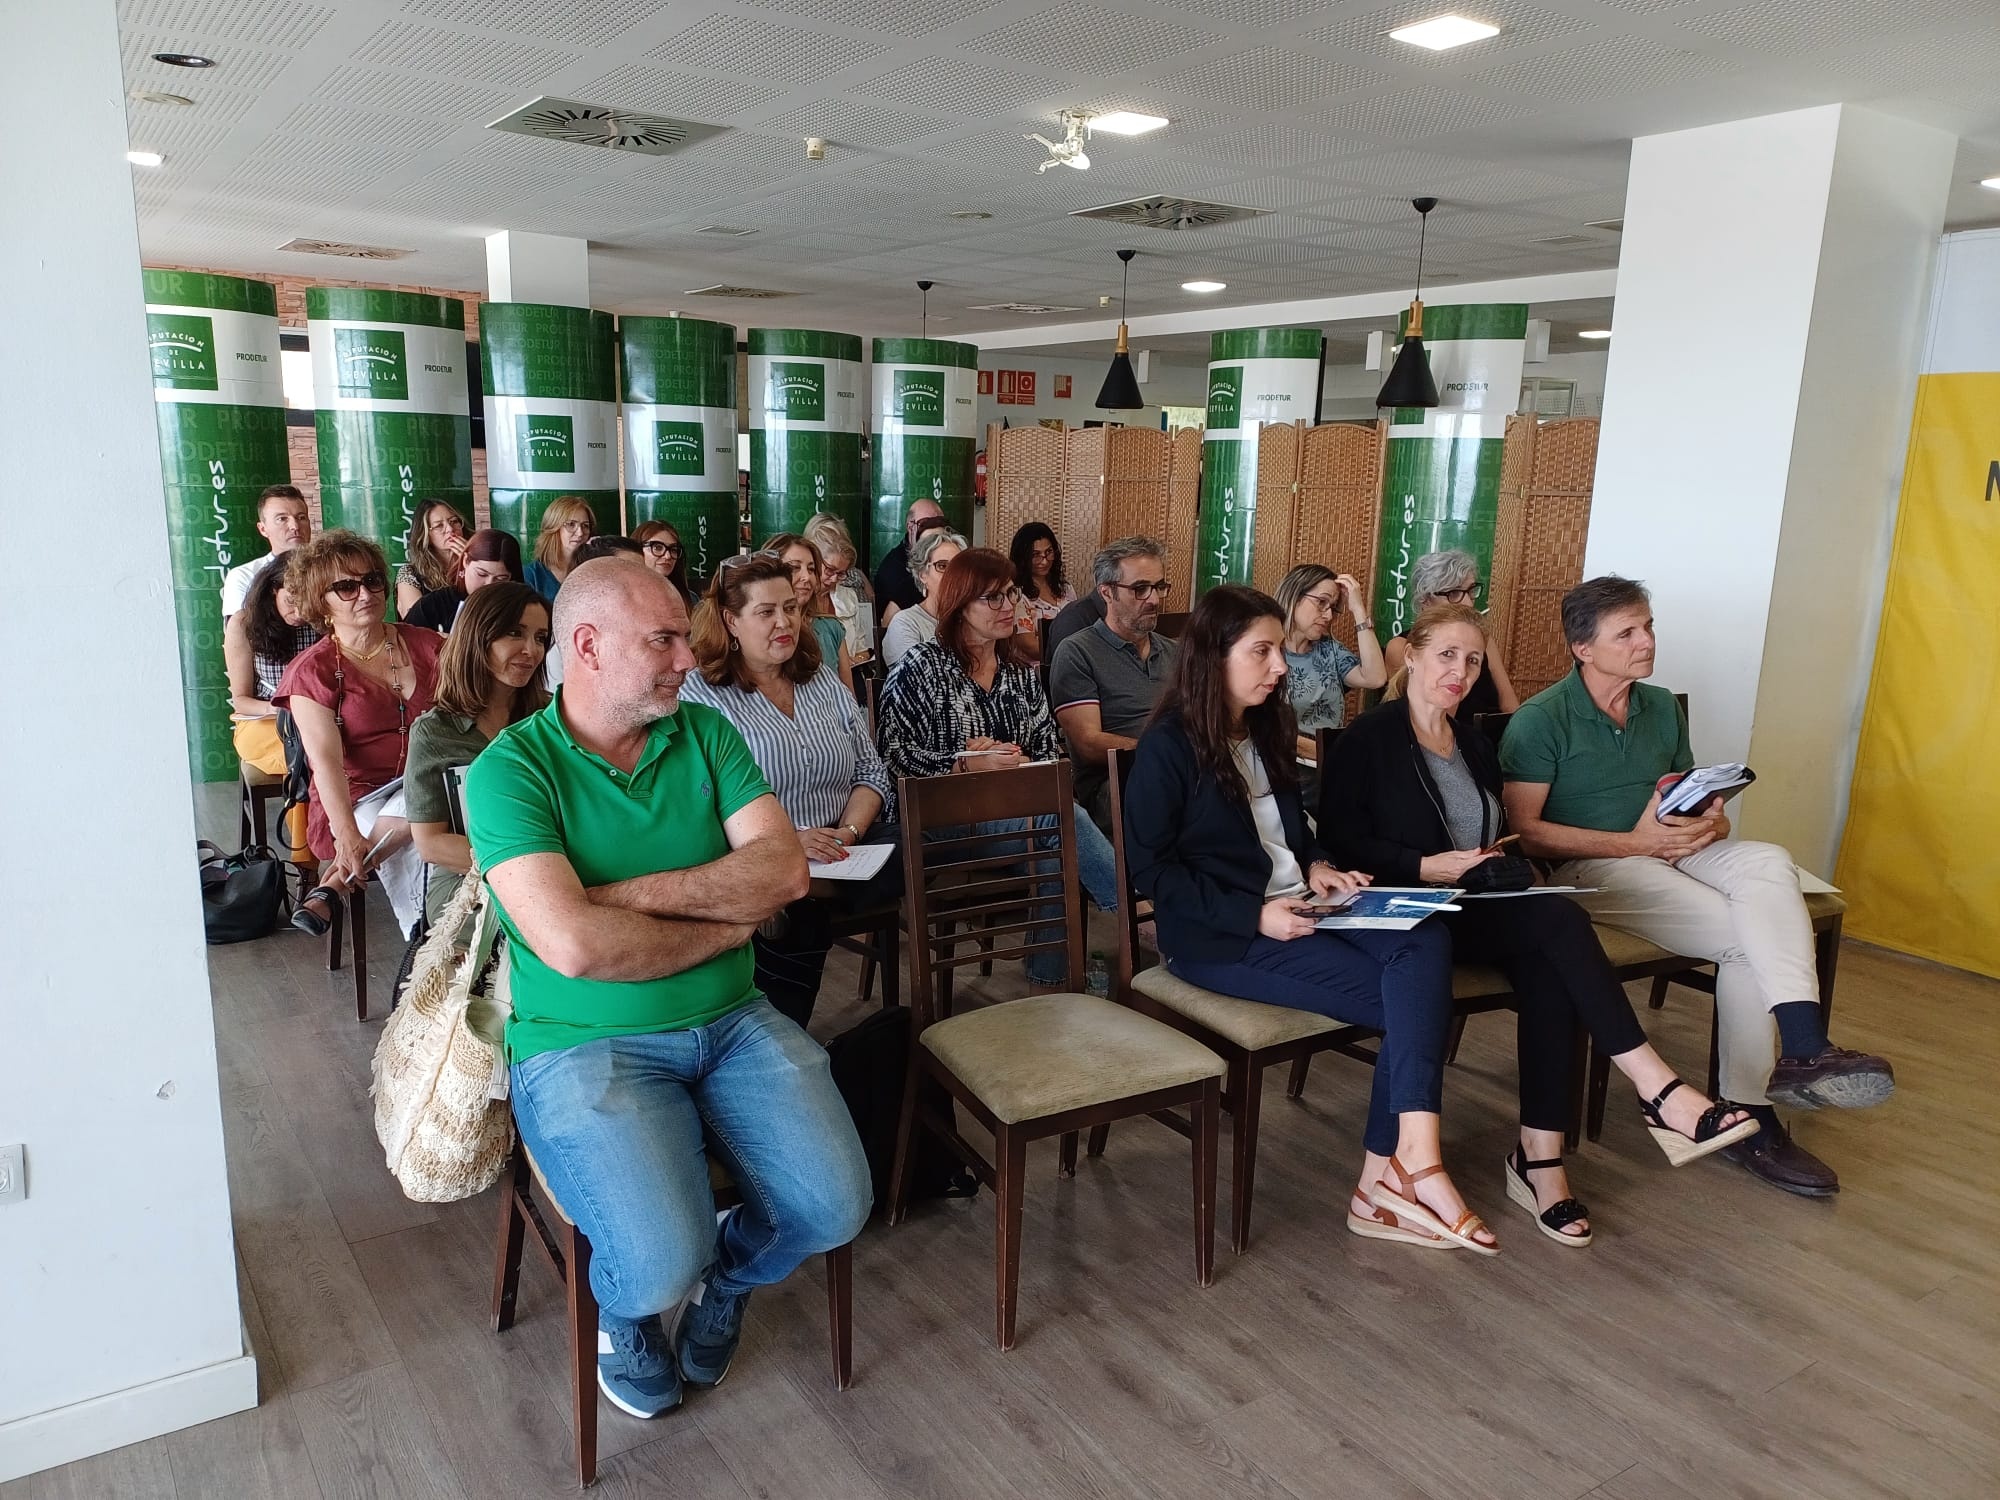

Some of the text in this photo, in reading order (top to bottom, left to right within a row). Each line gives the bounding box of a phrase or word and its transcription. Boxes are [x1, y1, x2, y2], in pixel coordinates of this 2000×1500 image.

[148, 331, 205, 348] IPUTACION
[236, 352, 268, 362] PRODETUR
[154, 358, 205, 371] EVILLA
[424, 364, 453, 374] PRODETUR
[899, 383, 939, 395] DIPUTACION
[900, 402, 938, 412] SEVILLA
[658, 434, 699, 444] DIPUTACION
[524, 448, 567, 457] SEVILLA
[659, 453, 698, 461] SEVILLA
